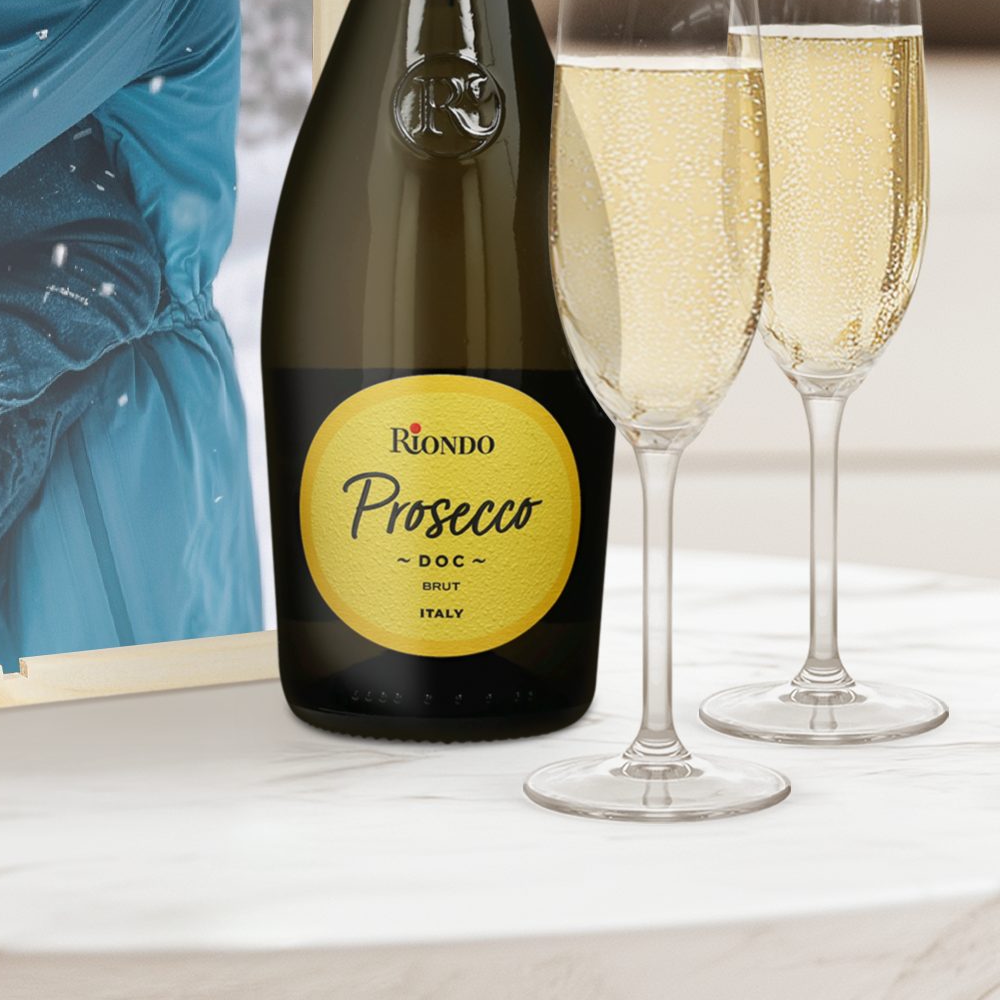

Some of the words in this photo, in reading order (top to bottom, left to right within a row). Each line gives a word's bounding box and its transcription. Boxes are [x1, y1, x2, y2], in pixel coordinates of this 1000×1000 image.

[342, 471, 543, 540] Prosecco
[418, 554, 465, 568] DOC
[422, 582, 461, 592] BRUT
[419, 608, 464, 619] ITALY
